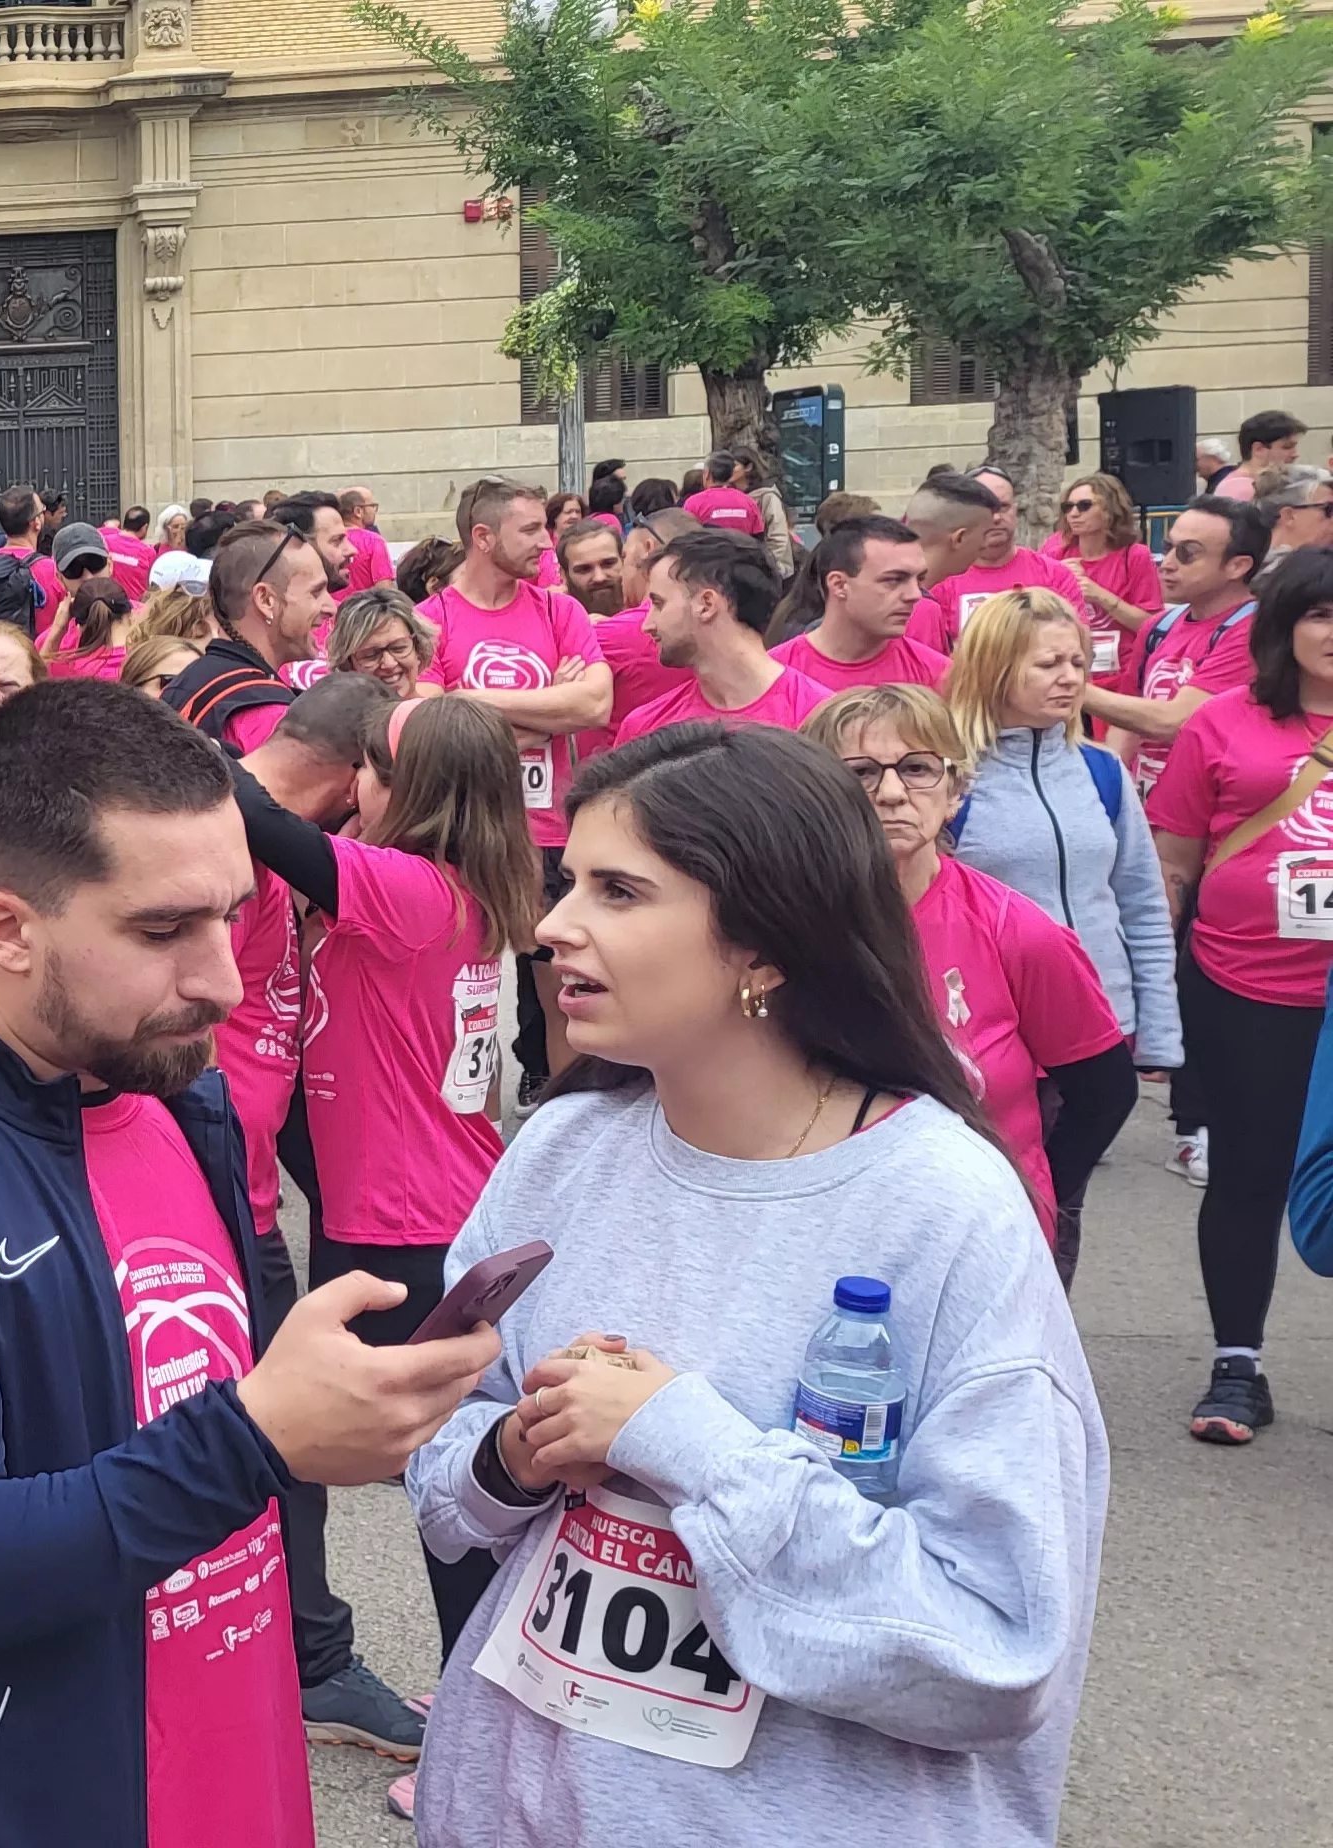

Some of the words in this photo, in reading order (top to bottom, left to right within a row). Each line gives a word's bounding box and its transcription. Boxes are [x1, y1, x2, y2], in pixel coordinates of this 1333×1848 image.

[169, 1262, 204, 1273] HUESCA
[148, 1348, 209, 1388] Caminemos
[591, 1514, 656, 1548] HUESCA
[600, 1542, 628, 1566] EL
[638, 1551, 697, 1583] CÁN
[532, 1552, 742, 1695] 3104
